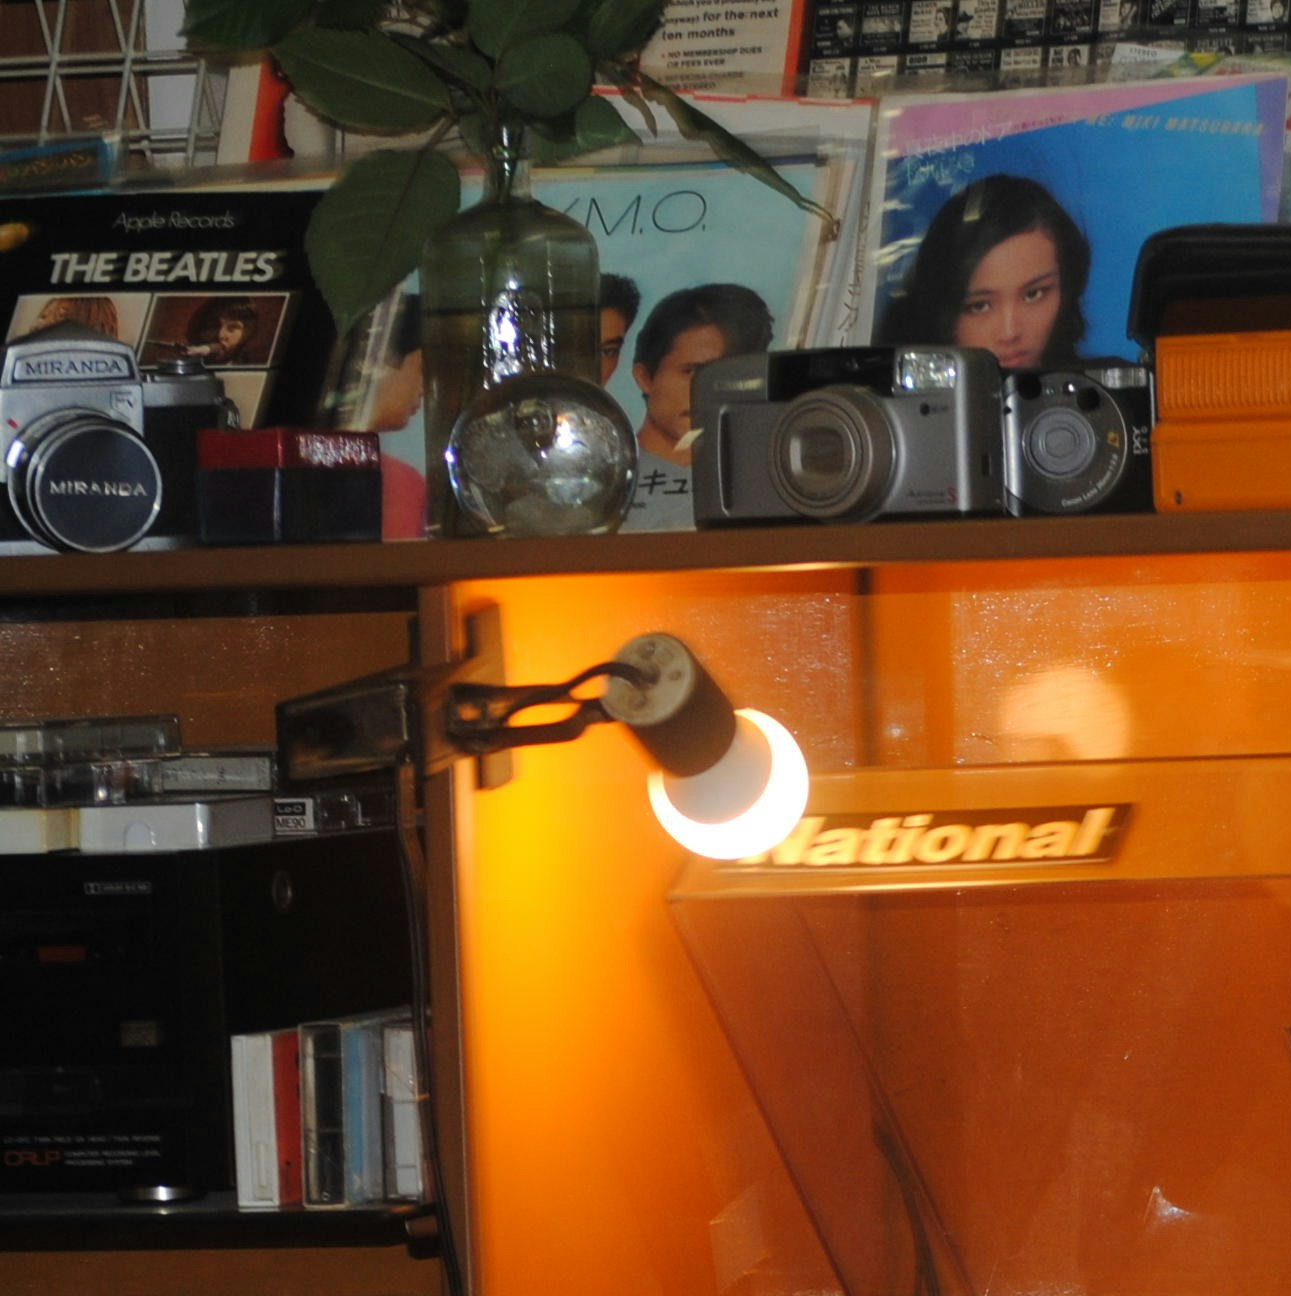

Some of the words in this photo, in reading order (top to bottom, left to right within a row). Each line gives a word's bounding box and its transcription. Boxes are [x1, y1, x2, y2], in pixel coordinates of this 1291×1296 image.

[703, 12, 720, 21] for
[725, 10, 745, 20] the
[750, 8, 779, 18] next
[662, 31, 682, 40] ten
[687, 27, 735, 38] months
[112, 210, 165, 233] Apple
[167, 210, 236, 229] Records
[50, 252, 121, 284] THE
[125, 250, 279, 284] BEATLES
[25, 360, 122, 376] MIRANDA
[49, 480, 148, 497] MIRANDA
